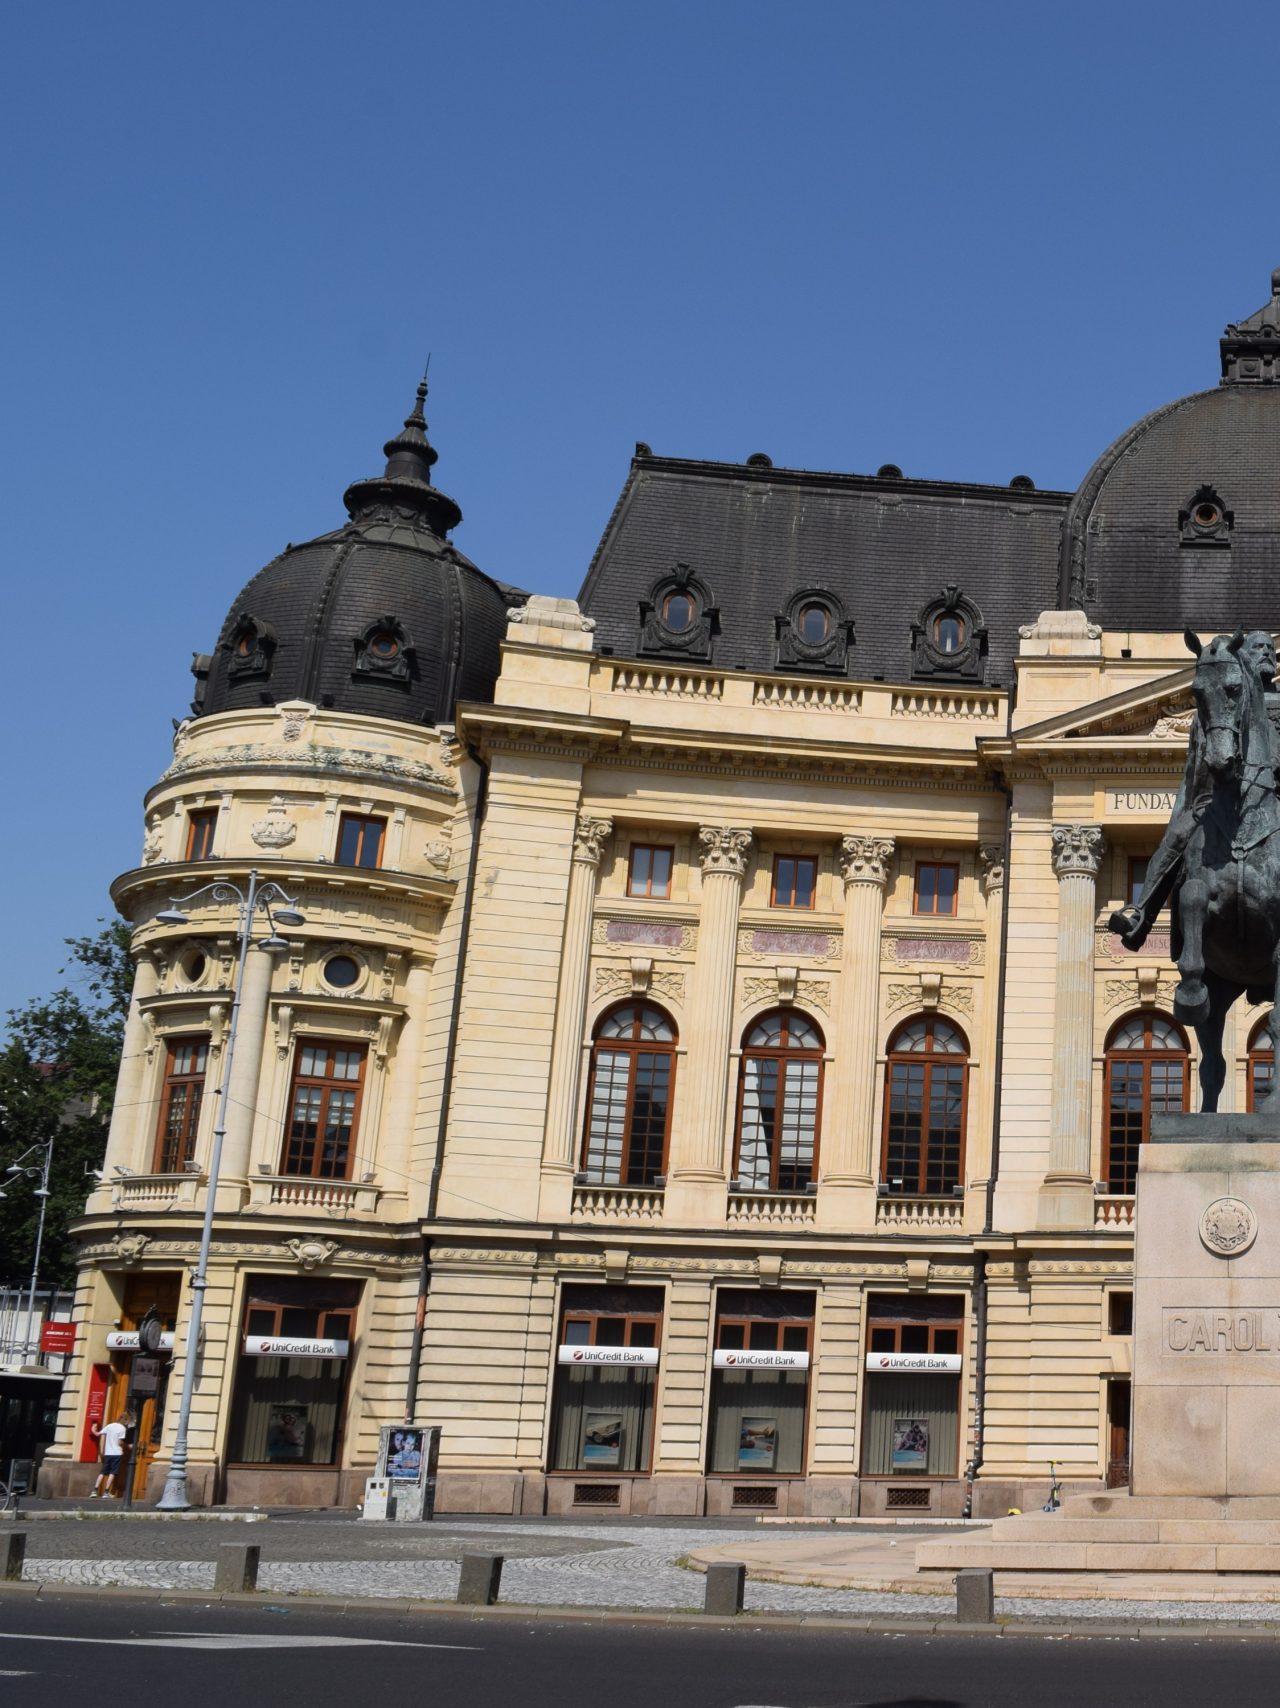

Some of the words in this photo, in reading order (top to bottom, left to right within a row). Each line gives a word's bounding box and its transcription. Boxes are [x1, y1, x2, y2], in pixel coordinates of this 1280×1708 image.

[1168, 1312, 1271, 1352] CAROL
[271, 1343, 311, 1353] UniCredit
[312, 1344, 335, 1354] Bank
[584, 1351, 622, 1361] UniCredit
[623, 1352, 645, 1362] Bank
[737, 1355, 773, 1365] UniCredit
[774, 1356, 796, 1366] Bank
[890, 1358, 927, 1368] UniCredit
[927, 1359, 948, 1368] Bank
